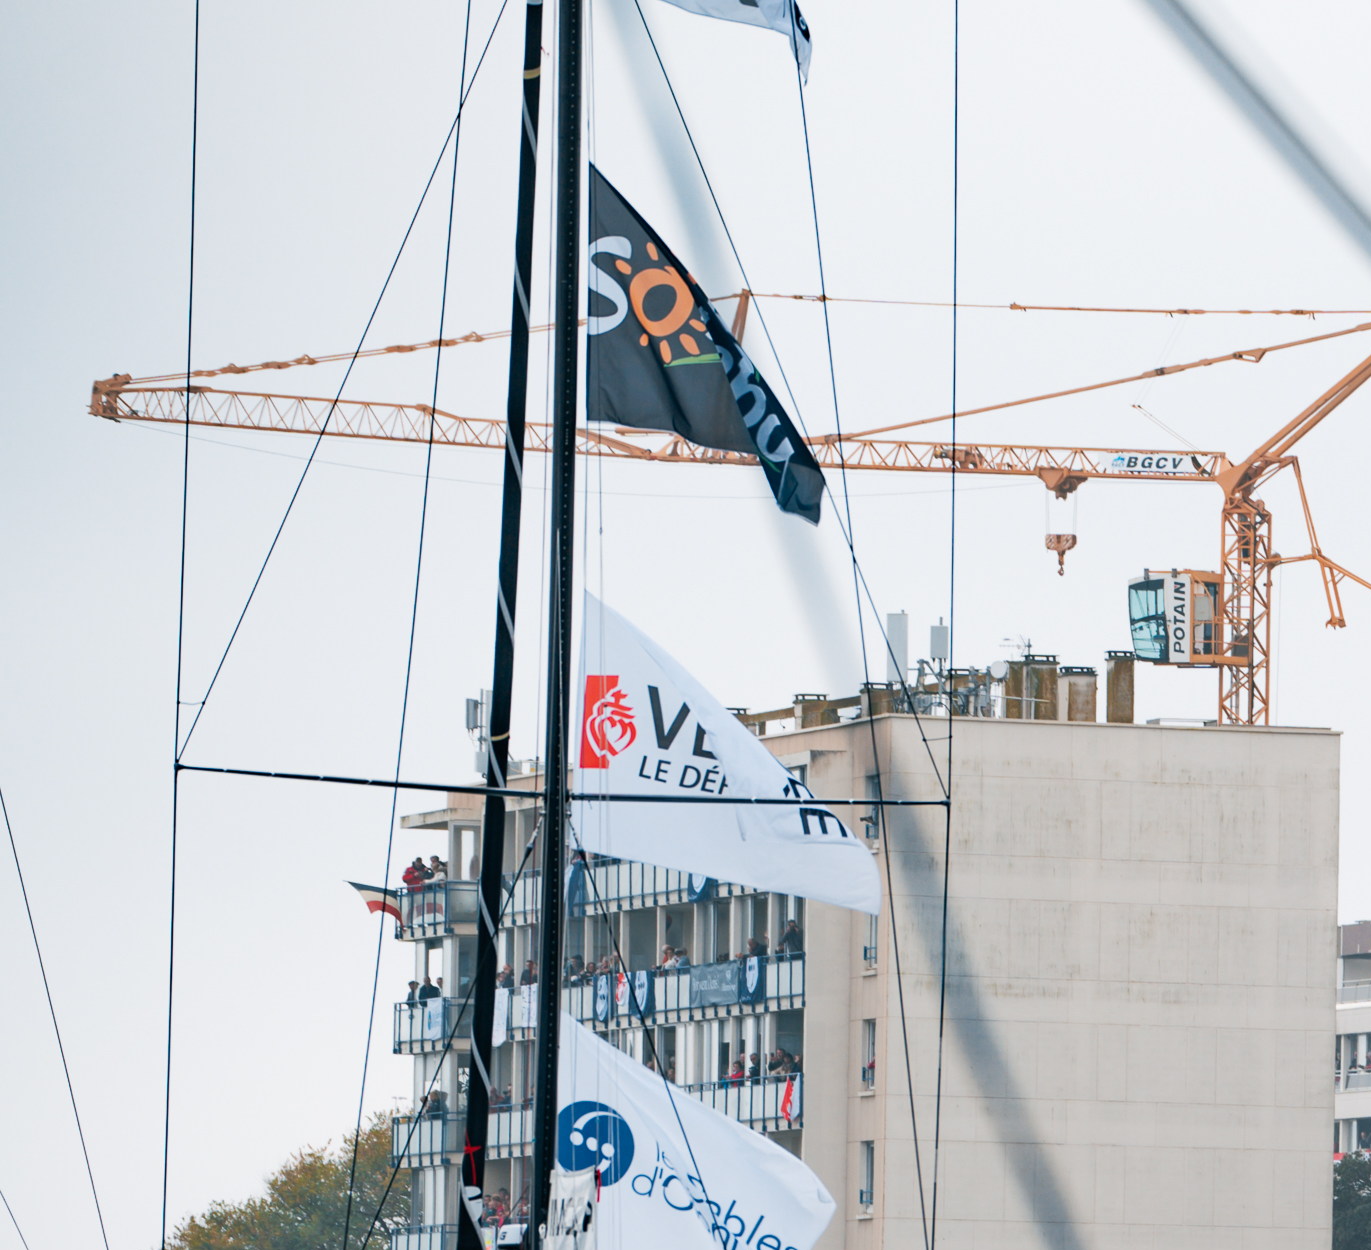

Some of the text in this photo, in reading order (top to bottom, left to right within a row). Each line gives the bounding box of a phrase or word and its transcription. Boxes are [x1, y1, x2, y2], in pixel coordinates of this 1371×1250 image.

[1126, 456, 1183, 469] BGCV
[1173, 581, 1186, 654] POTAIN
[639, 755, 671, 783] LE
